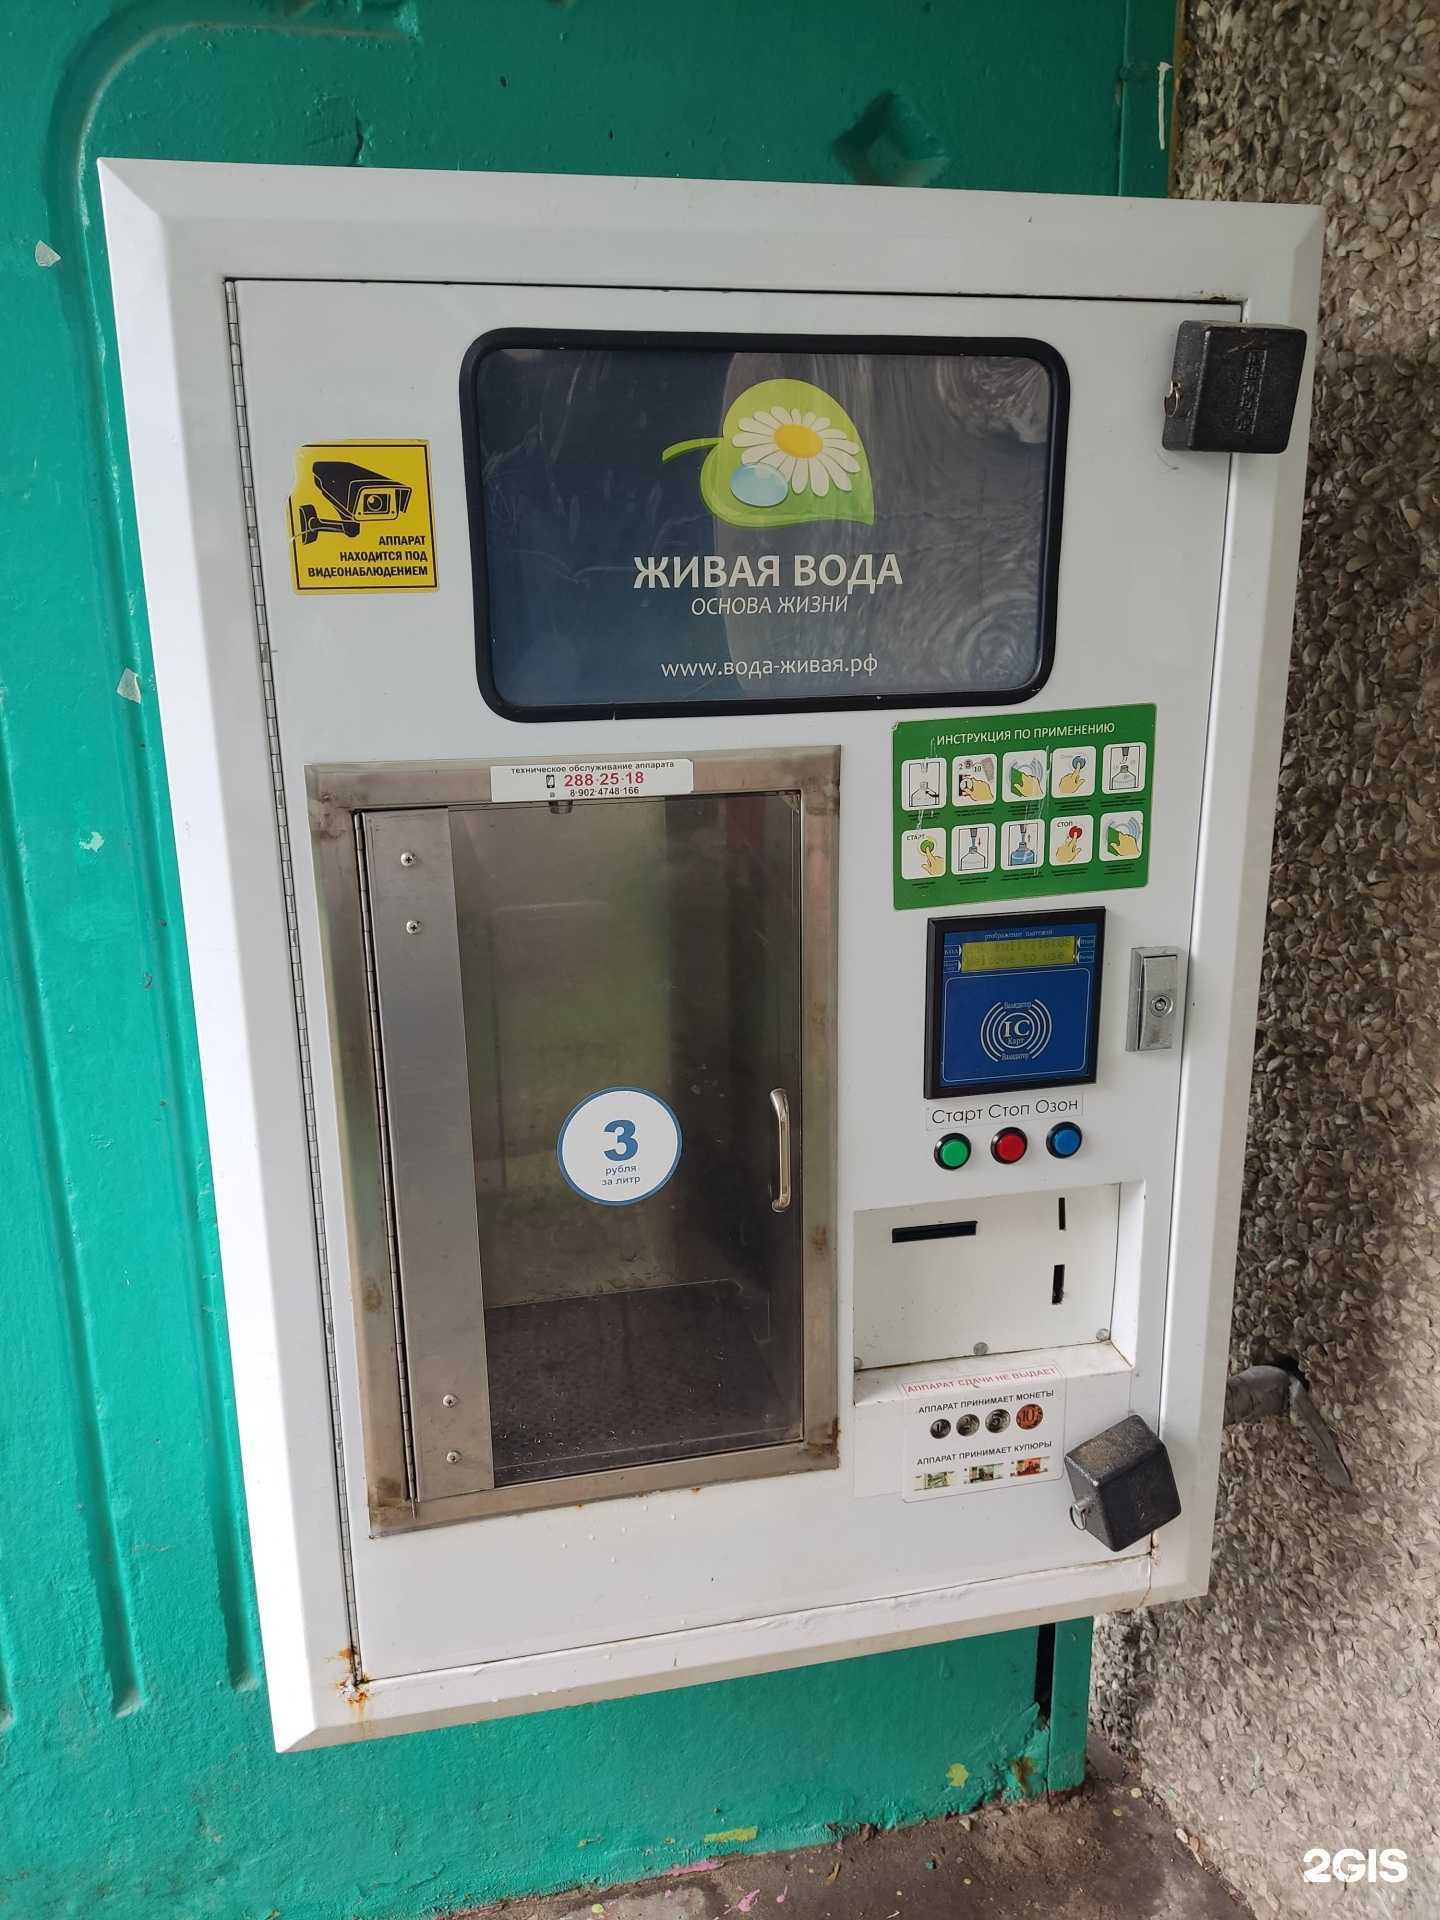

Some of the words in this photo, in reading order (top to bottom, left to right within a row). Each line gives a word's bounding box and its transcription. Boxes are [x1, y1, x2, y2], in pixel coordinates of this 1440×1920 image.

[379, 536, 426, 546] АППАРАТ
[340, 551, 402, 562] НАХОДИТСЯ
[405, 551, 428, 562] ПОД
[308, 566, 428, 578] ВИДЕОНАБЛЮДЕНИЕМ
[633, 555, 780, 589] ЖИВАЯ
[794, 554, 903, 594] ВОДА
[691, 597, 772, 616] ОСНОВА
[777, 595, 848, 614] ЖИЗНИ
[661, 653, 878, 679] www.вода-живая.рф
[937, 729, 1011, 746] ИНСТРУКЦИЯ
[1014, 728, 1031, 740] ПО
[1034, 722, 1115, 739] ПРИМЕНЕНИЮ
[512, 766, 566, 775] техническое
[569, 763, 633, 774] обслуживание
[635, 760, 674, 770] аппарата
[974, 765, 982, 773] 10
[1057, 820, 1073, 828] СТОП
[1003, 1019, 1031, 1037] IC
[932, 1108, 983, 1124] Старт
[988, 1103, 1030, 1118] Стоп
[1035, 1099, 1078, 1113] Озон
[604, 1119, 638, 1161] 3
[605, 1164, 637, 1176] рубля
[601, 1178, 613, 1186] за
[616, 1176, 640, 1185] литр
[907, 1380, 954, 1393] АППАРАТ
[958, 1375, 993, 1387] СДАЧИ
[995, 1373, 1009, 1382] НЕ
[1013, 1367, 1057, 1380] ВЫДАЕТ
[918, 1402, 958, 1414] АППАРАТ
[961, 1395, 1014, 1408] ПРИНИМАЕТ
[1016, 1390, 1054, 1401] МОНЕТЫ
[917, 1454, 955, 1465] АППАРАТ
[959, 1447, 1011, 1460] ПРИНИМАЕТ
[1014, 1441, 1052, 1452] КУПЮРЫ
